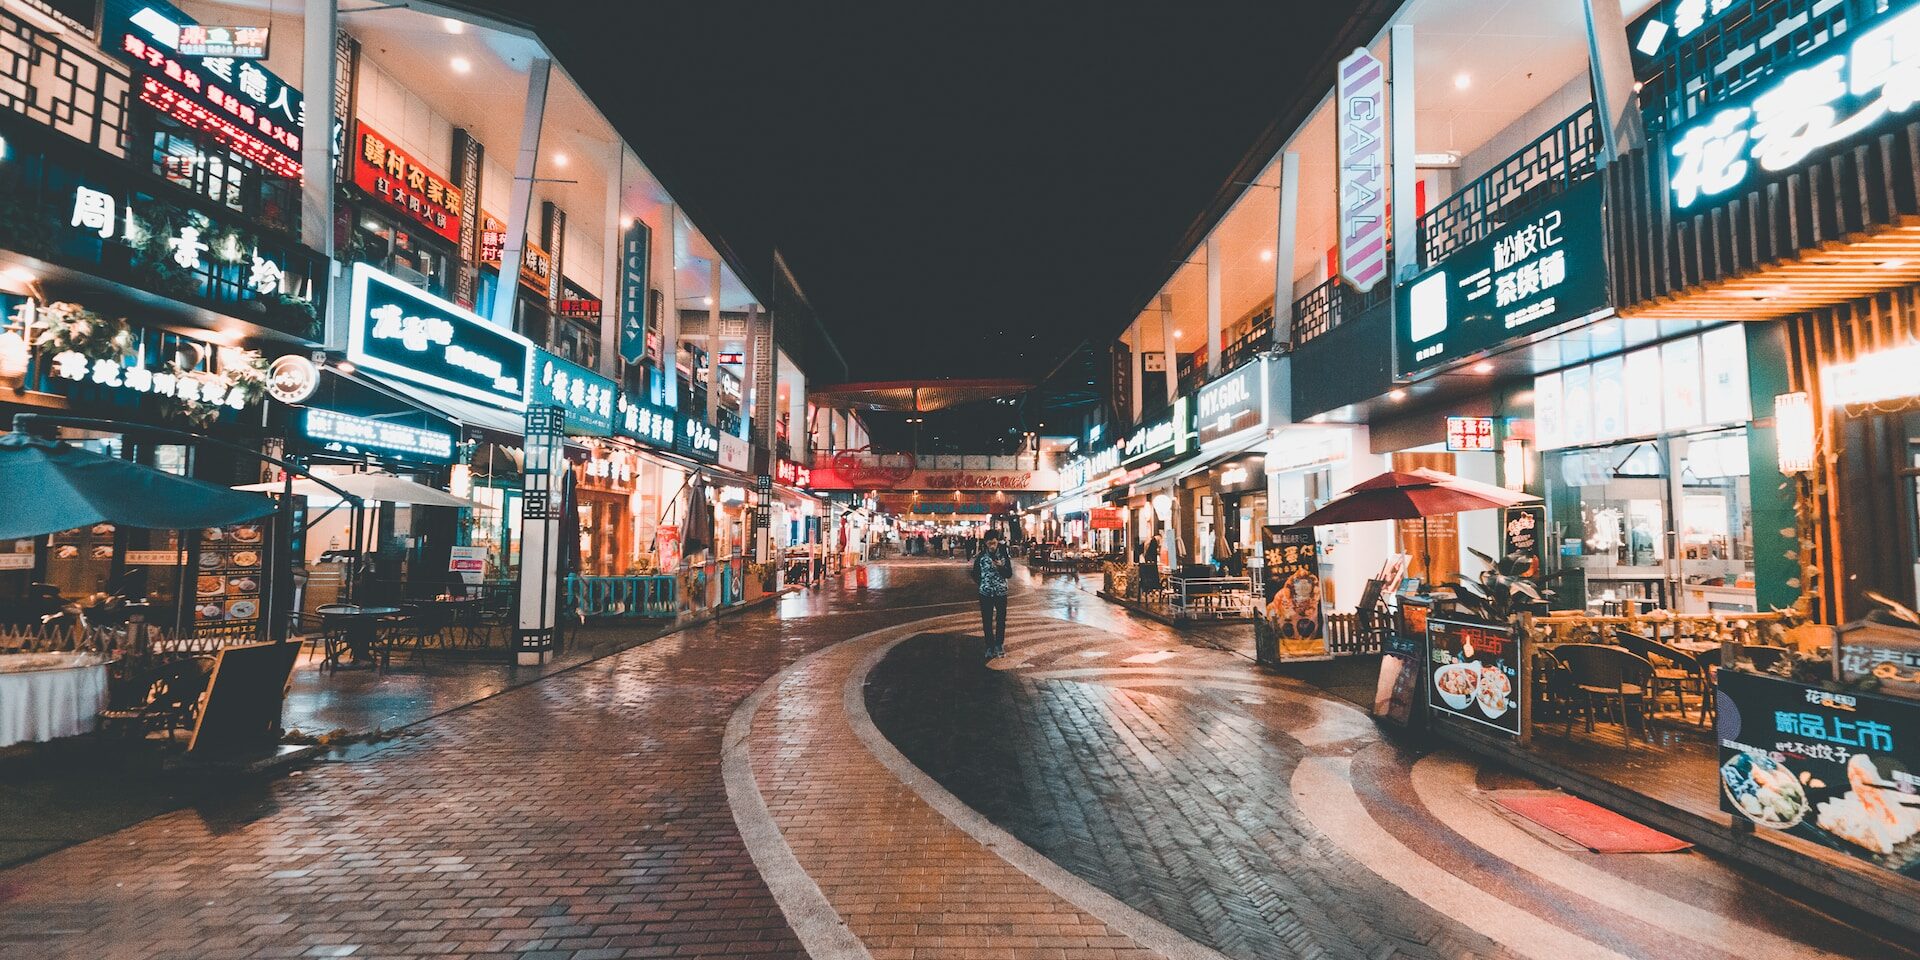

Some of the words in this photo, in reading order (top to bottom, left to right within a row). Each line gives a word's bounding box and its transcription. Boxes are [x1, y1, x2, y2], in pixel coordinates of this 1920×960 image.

[364, 133, 460, 217] 赣村农家菜
[1349, 96, 1377, 238] CATAL
[376, 177, 448, 229] 红太阳火锅
[1492, 209, 1564, 272] 松枝记
[1494, 249, 1566, 308] 茶货铺
[1774, 710, 1893, 752] 新品上市
